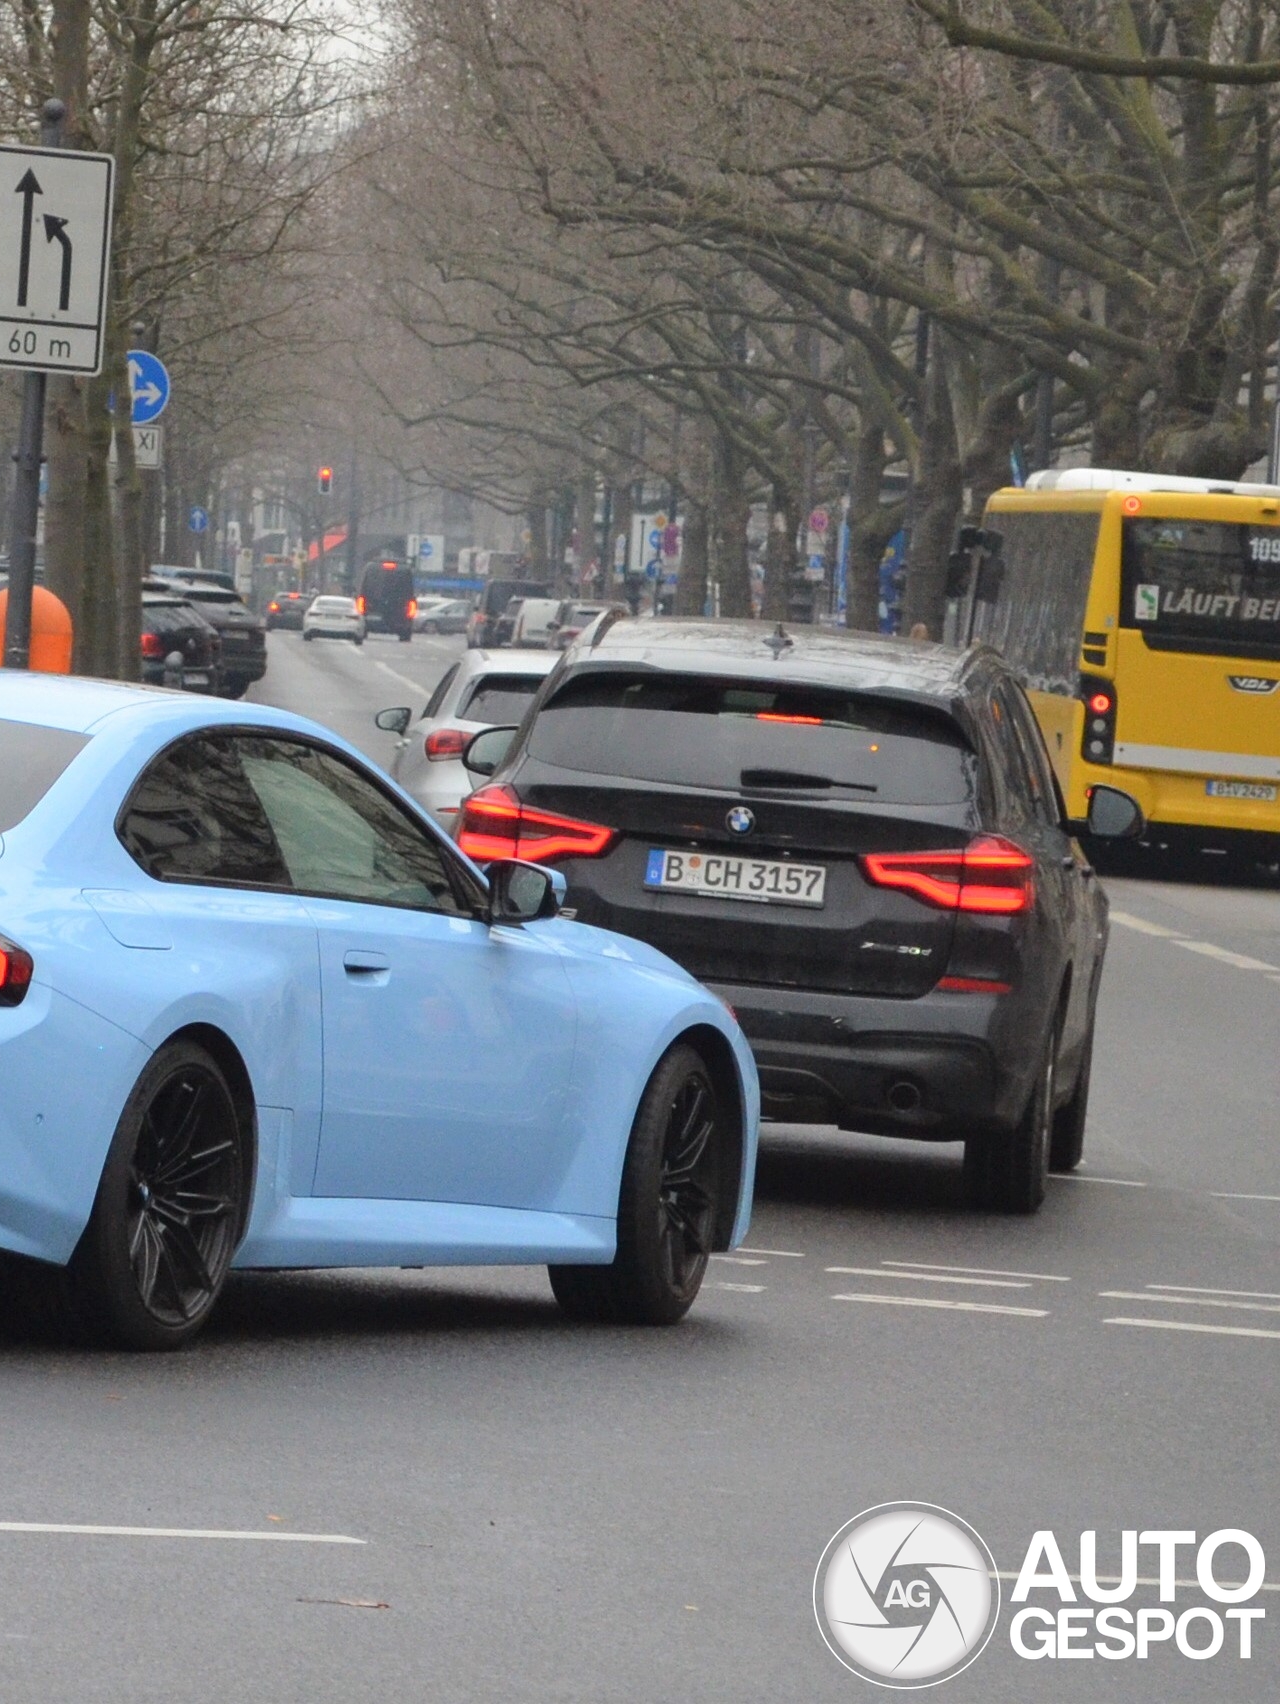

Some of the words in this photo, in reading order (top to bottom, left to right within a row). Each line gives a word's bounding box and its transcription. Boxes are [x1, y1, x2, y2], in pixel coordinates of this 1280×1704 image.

[8, 329, 37, 355] 60
[49, 339, 71, 359] m
[138, 432, 157, 451] XI
[1163, 588, 1240, 617] LÄUFT
[665, 855, 683, 882] B
[704, 858, 742, 889] CH
[748, 863, 821, 897] 3157
